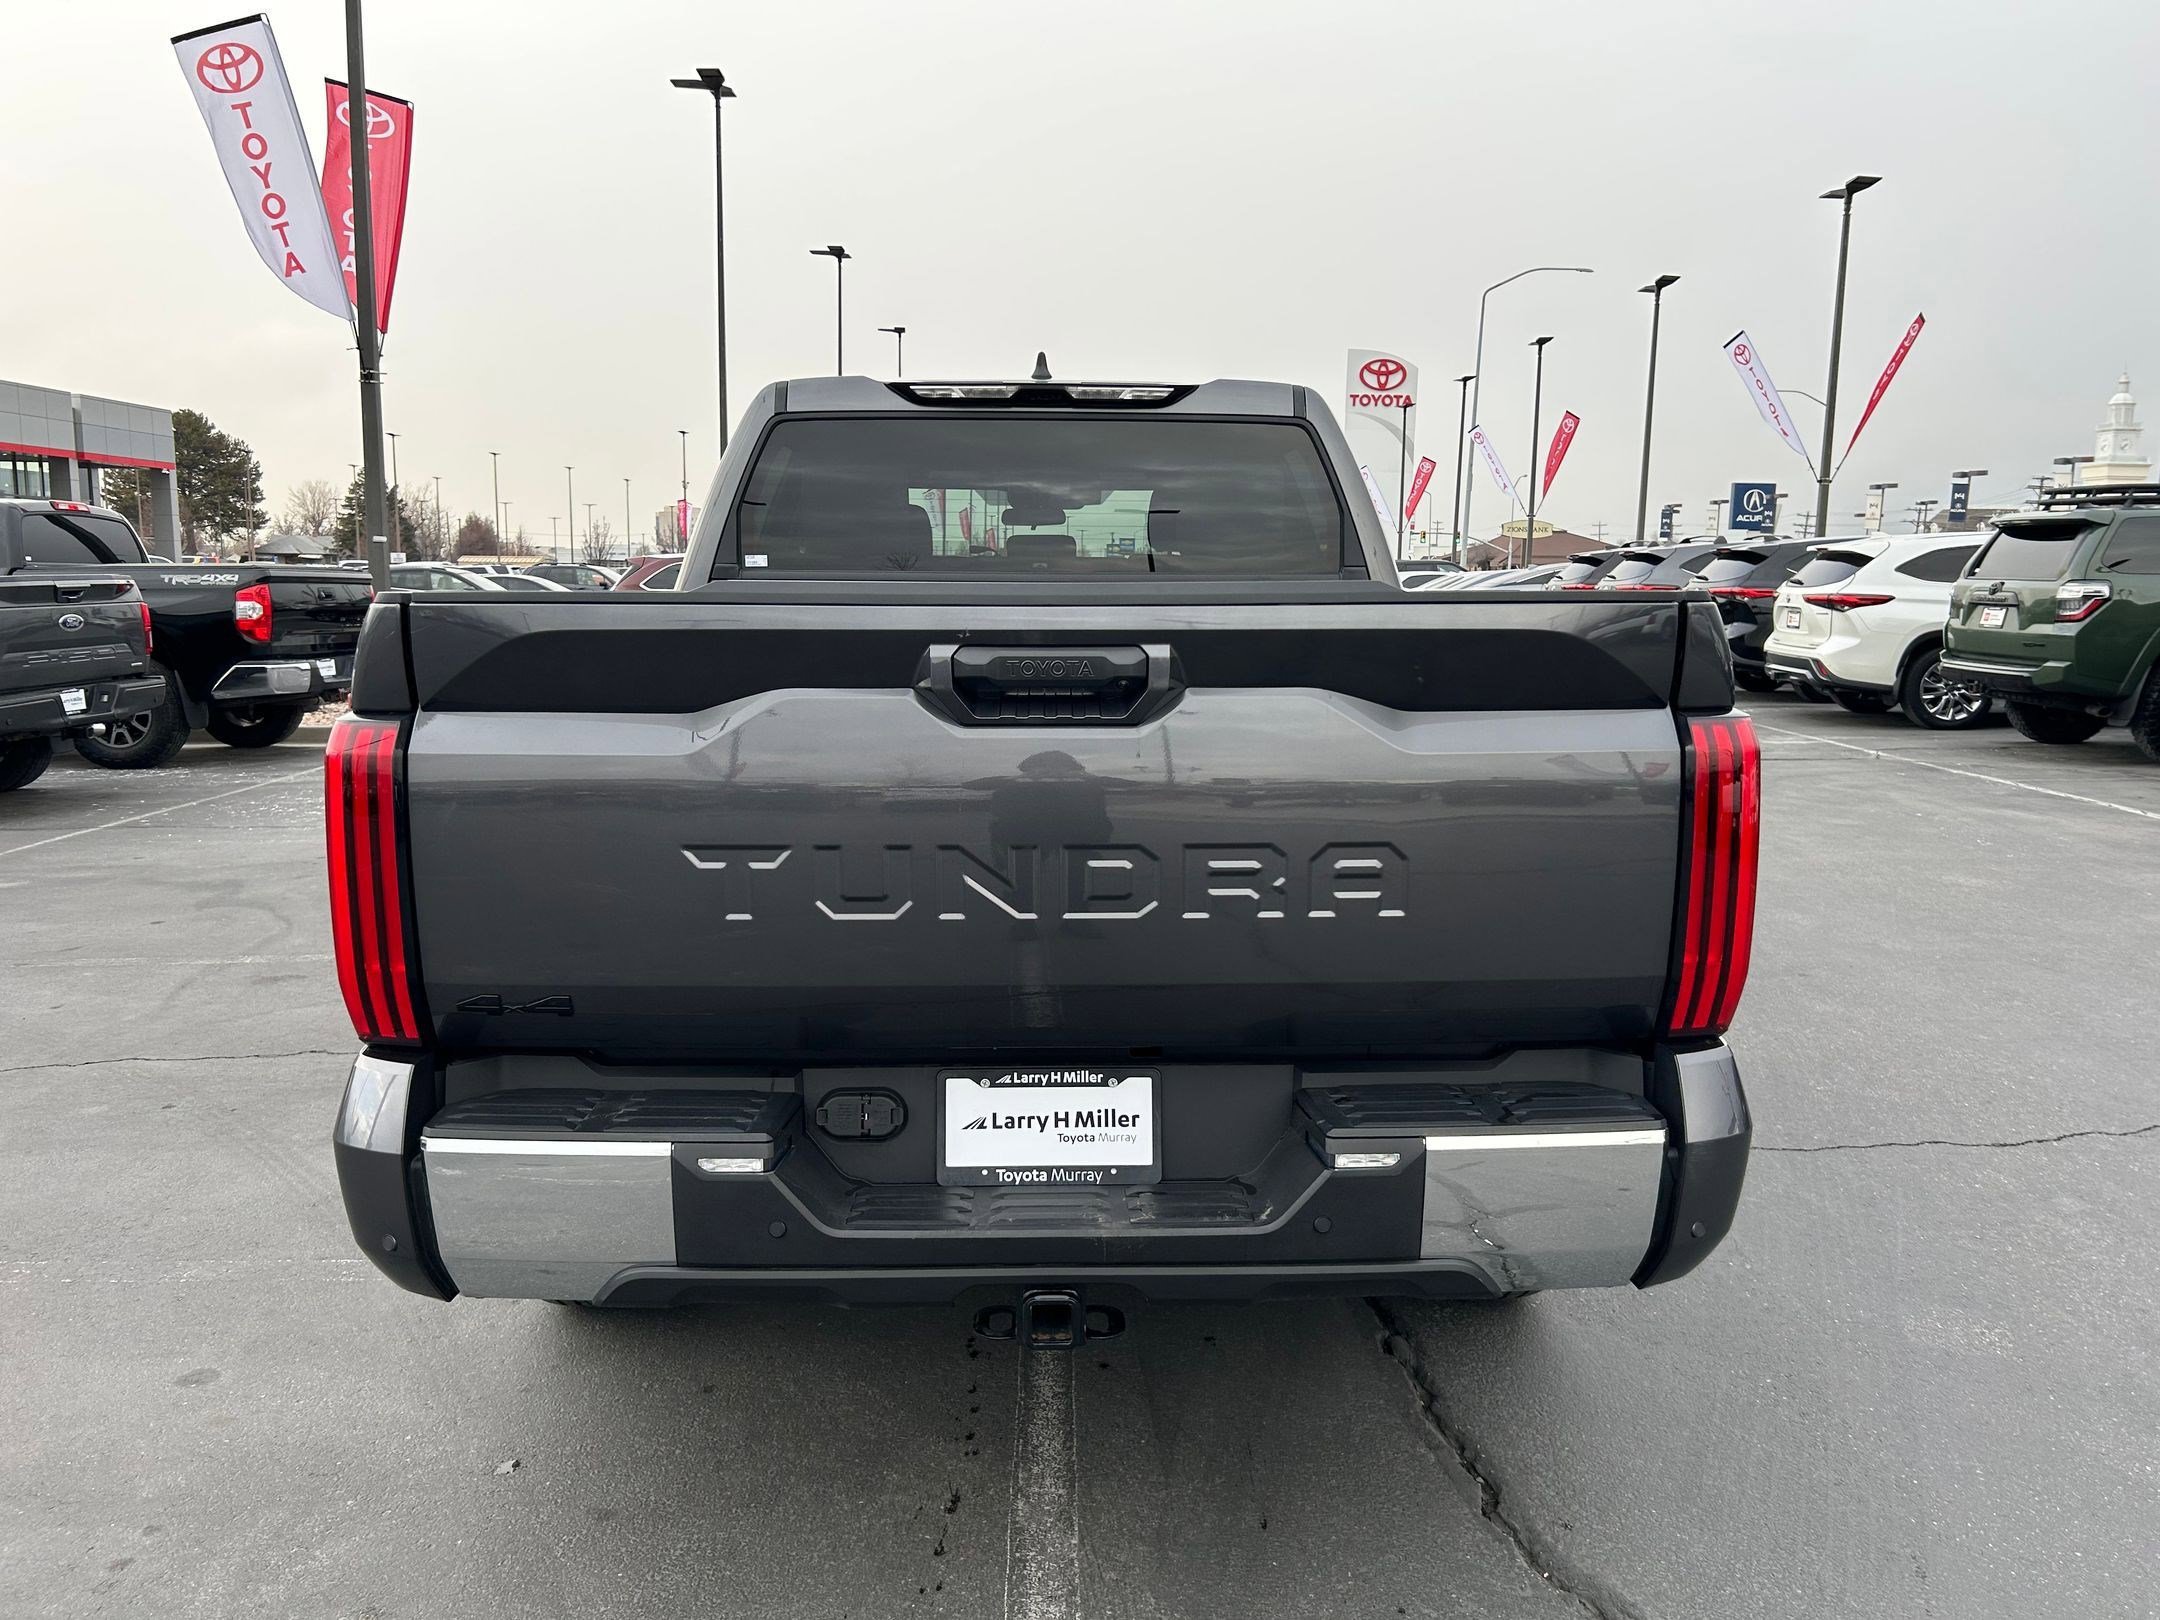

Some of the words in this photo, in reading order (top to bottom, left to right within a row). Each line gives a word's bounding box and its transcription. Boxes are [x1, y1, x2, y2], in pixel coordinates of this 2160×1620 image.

[231, 101, 307, 278] TOYOTA
[1349, 394, 1413, 407] TOYOTA
[1736, 514, 1762, 522] ACUR
[1006, 660, 1095, 678] TOYOTA
[680, 842, 1409, 921] TUNDRA
[1013, 1071, 1049, 1086] Larry
[1050, 1072, 1061, 1083] H
[1063, 1070, 1104, 1084] Miller
[992, 1112, 1049, 1132] Larry
[1054, 1111, 1069, 1128] H
[1074, 1109, 1140, 1128] Miller
[1057, 1133, 1095, 1144] Toyota
[1098, 1132, 1137, 1144] Murray
[996, 1168, 1048, 1184] Toyota
[1051, 1168, 1104, 1184] Murray
